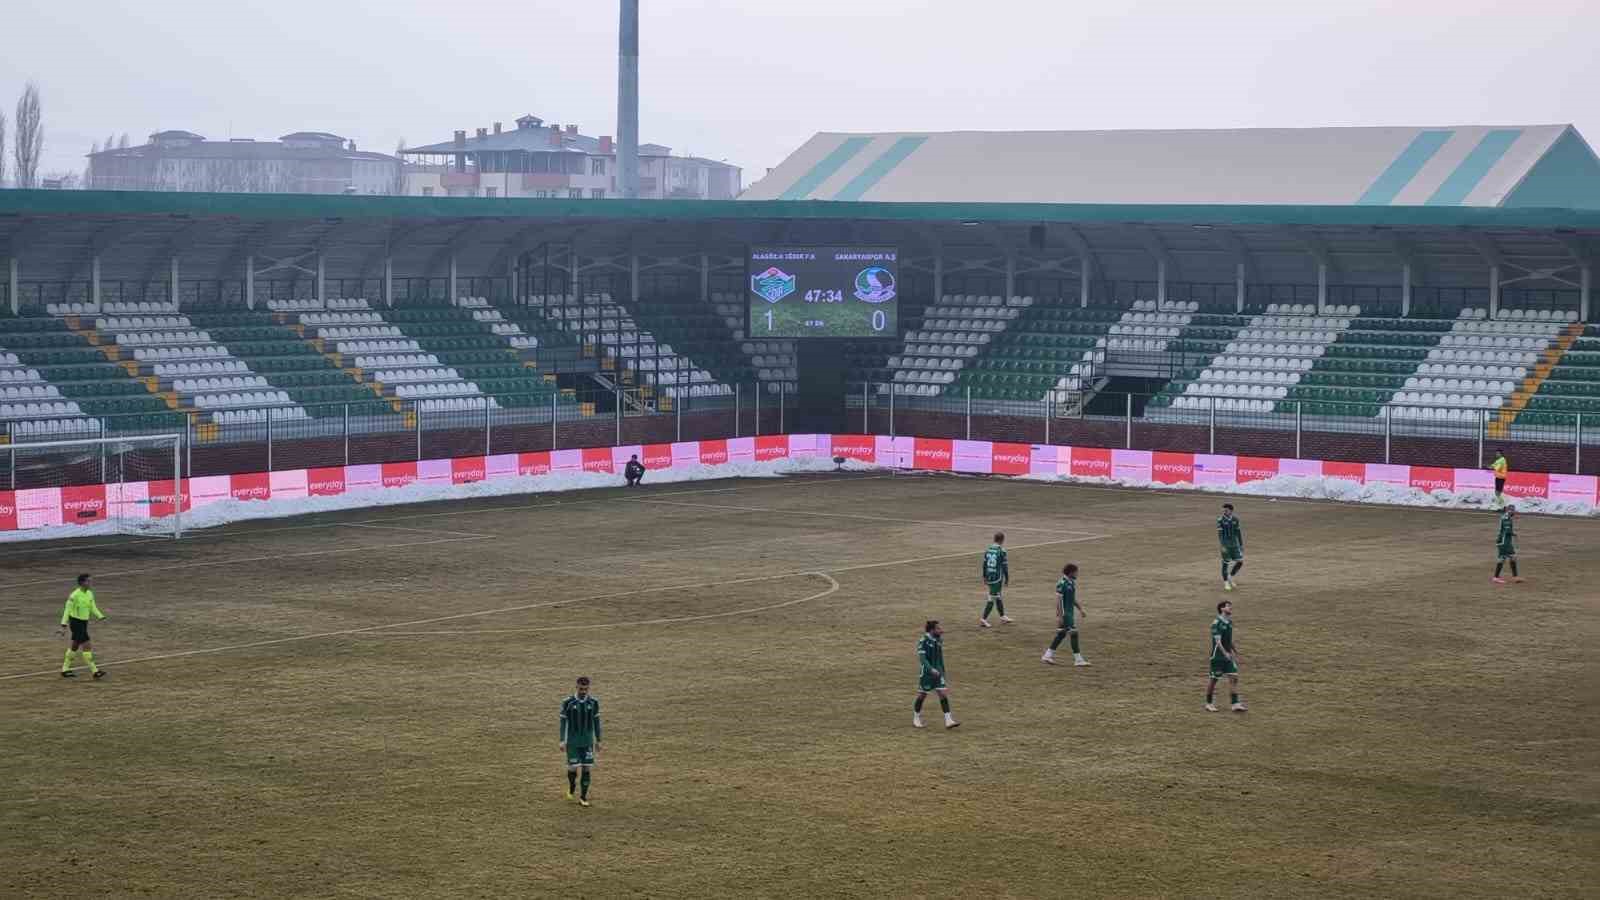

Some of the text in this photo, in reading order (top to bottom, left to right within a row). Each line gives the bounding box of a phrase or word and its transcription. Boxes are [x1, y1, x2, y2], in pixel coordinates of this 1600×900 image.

[804, 290, 843, 303] 47:34
[764, 309, 772, 331] 1
[872, 309, 886, 331] 0
[756, 446, 787, 457] everyday
[833, 446, 873, 457] everyday
[916, 449, 950, 460] everyday
[994, 454, 1029, 465] everyday
[1072, 459, 1109, 470] everyday
[454, 469, 484, 480] everyday
[1154, 464, 1192, 475] everyday
[310, 480, 344, 491] everyday
[1412, 478, 1452, 490] everyday
[1504, 483, 1546, 496] everyday
[233, 487, 267, 499] everyday
[64, 499, 104, 511] everyday
